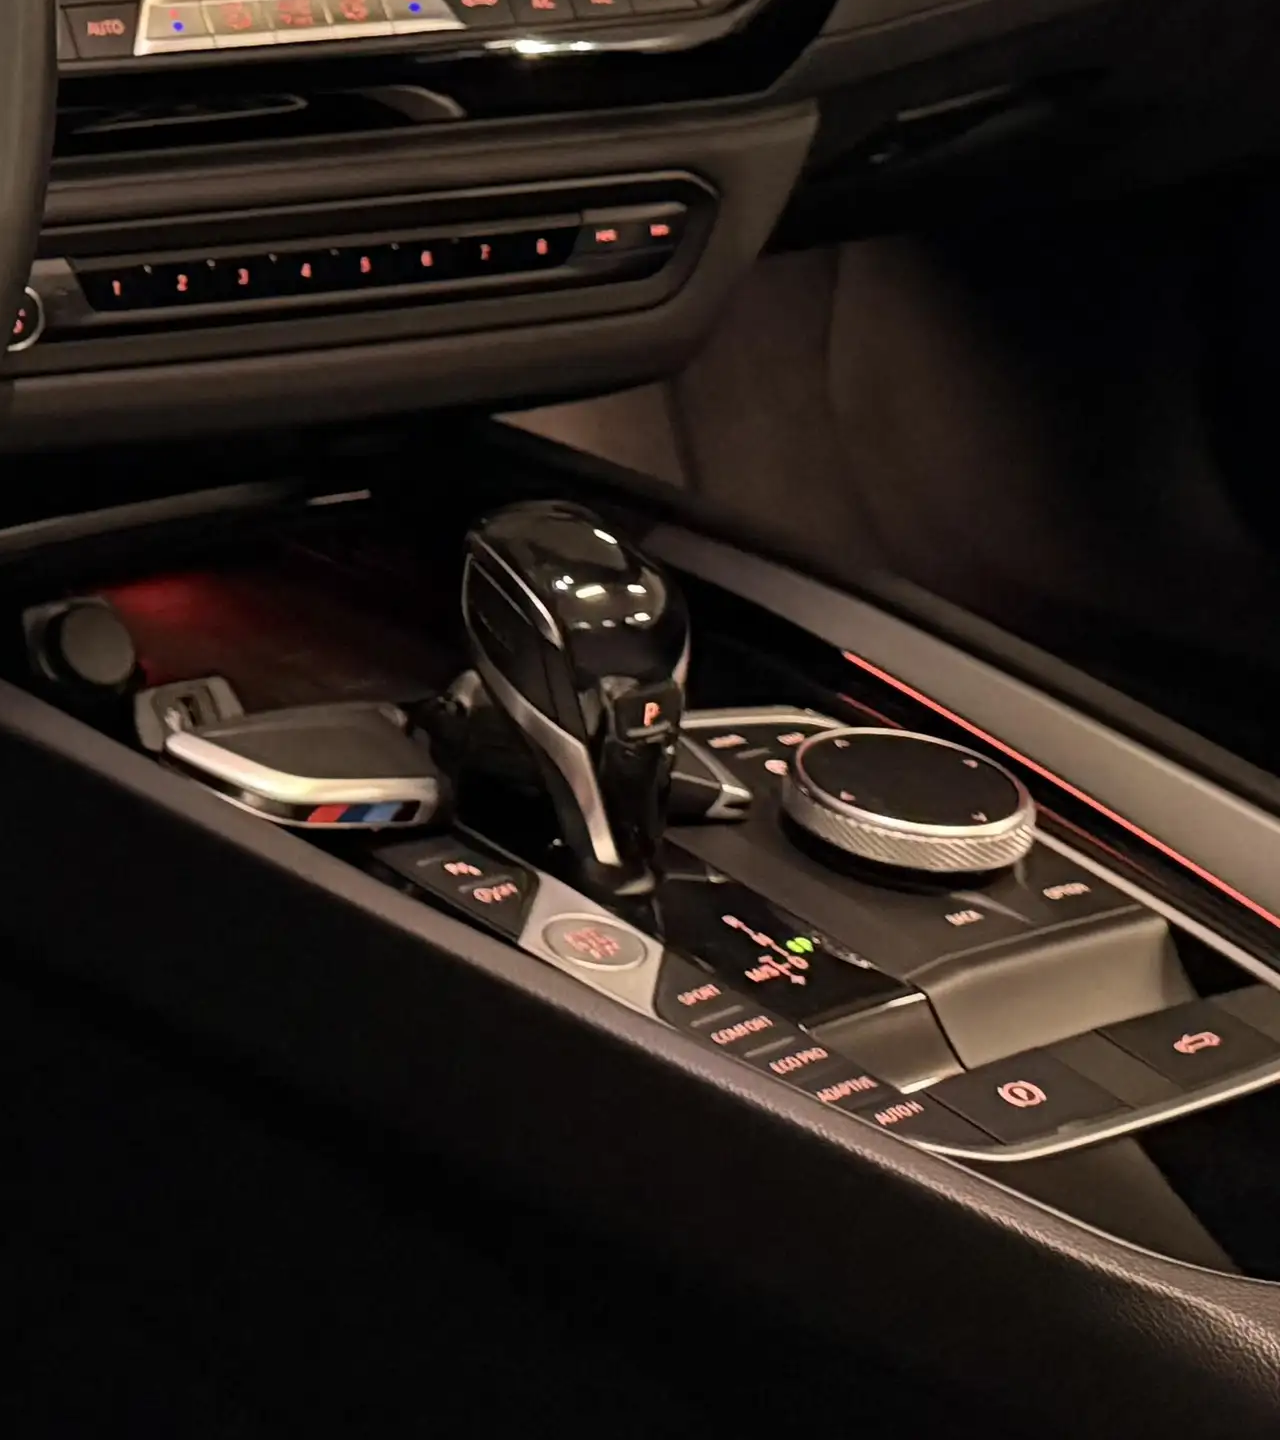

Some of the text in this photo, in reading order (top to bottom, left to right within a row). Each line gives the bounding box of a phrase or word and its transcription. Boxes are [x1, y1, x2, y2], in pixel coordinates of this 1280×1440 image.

[87, 18, 125, 37] AUTO
[643, 702, 660, 727] P
[677, 984, 722, 1006] SPORT
[710, 1015, 774, 1045] COMFORT
[769, 1053, 800, 1075] ECO
[816, 1075, 879, 1103] ADAPTIVE
[874, 1104, 908, 1125] AUTO
